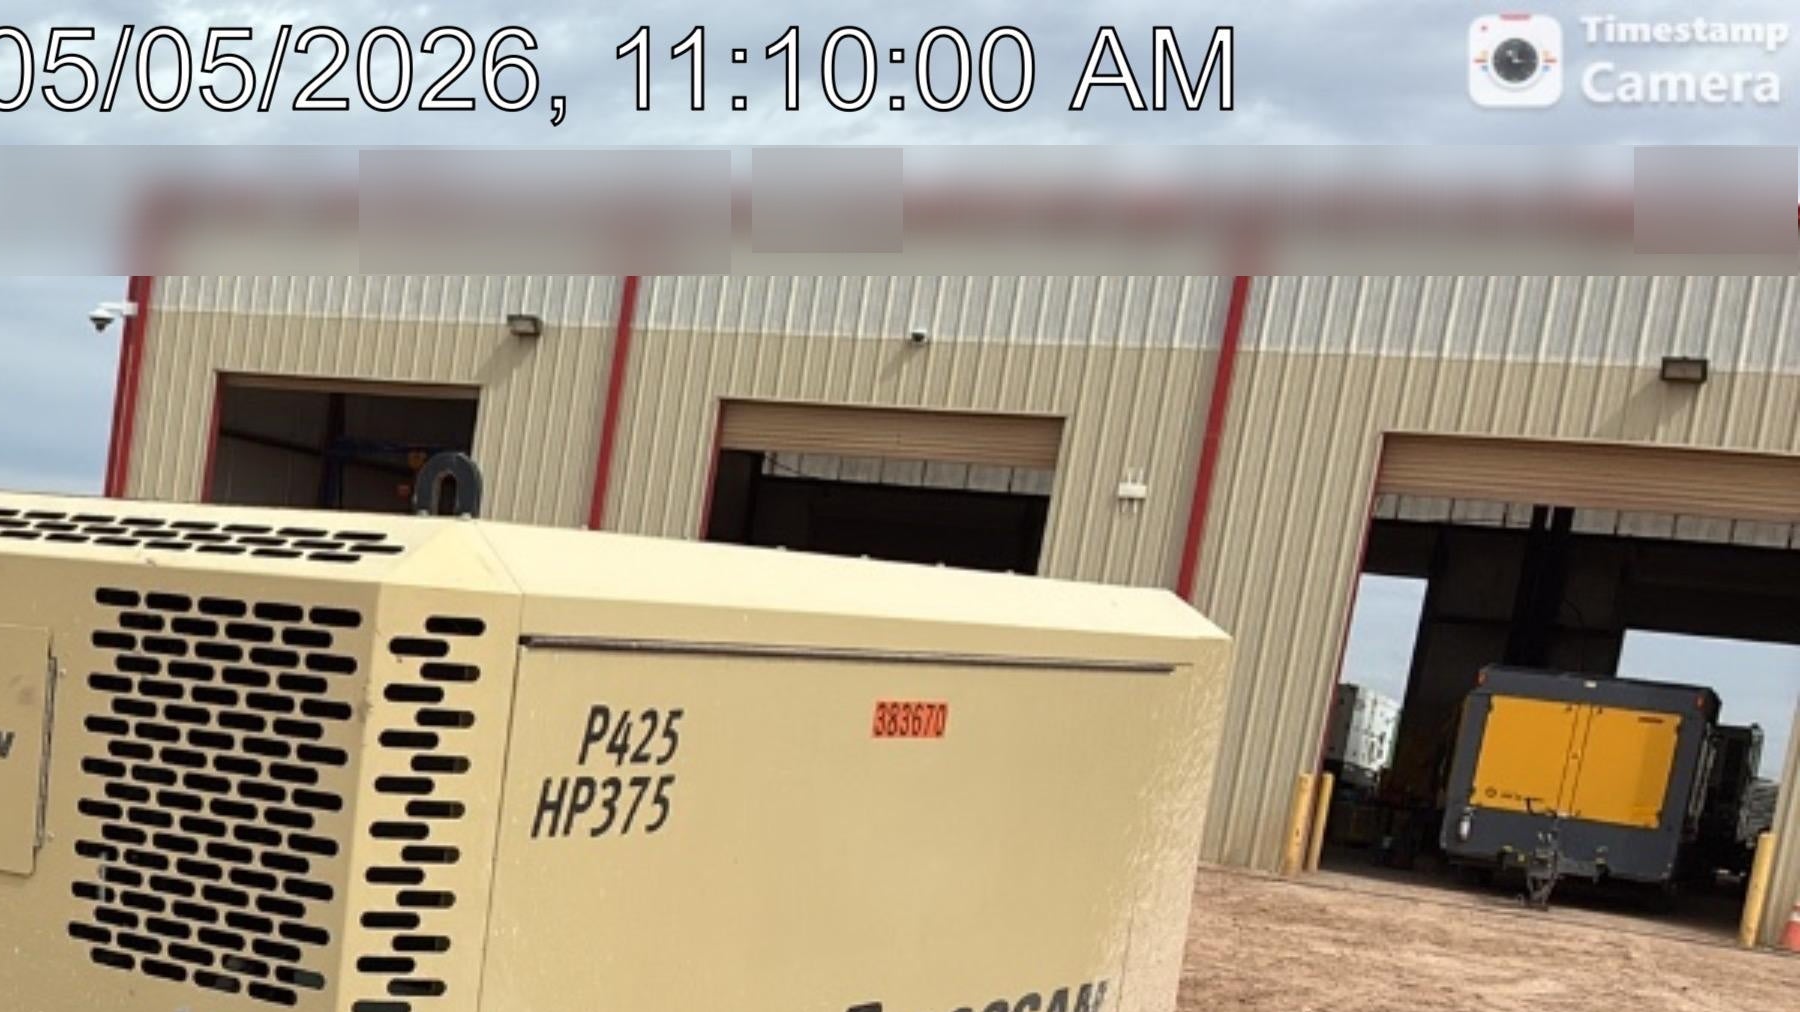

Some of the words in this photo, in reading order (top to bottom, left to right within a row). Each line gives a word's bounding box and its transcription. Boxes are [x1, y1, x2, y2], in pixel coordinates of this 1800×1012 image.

[578, 704, 684, 767] P425
[873, 702, 948, 737] 383670
[531, 774, 676, 838] HP375
